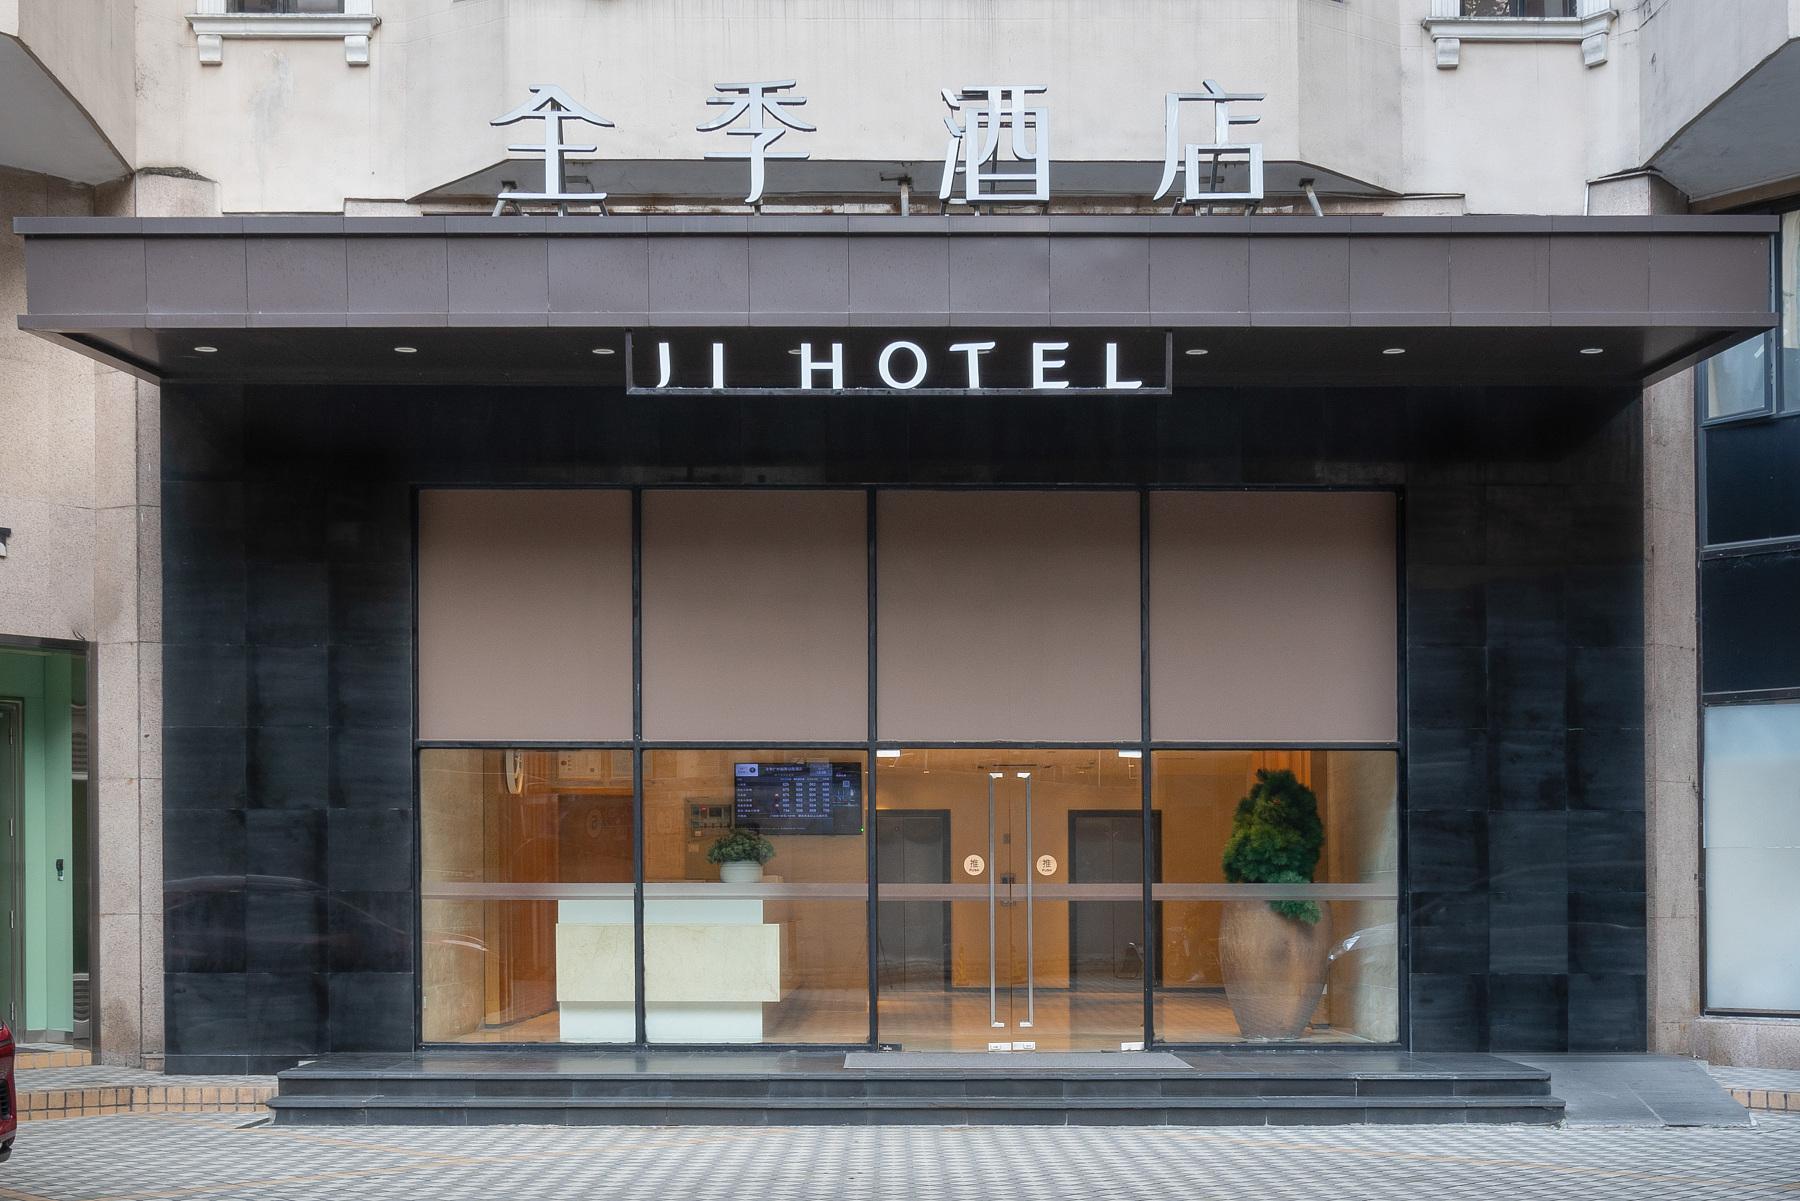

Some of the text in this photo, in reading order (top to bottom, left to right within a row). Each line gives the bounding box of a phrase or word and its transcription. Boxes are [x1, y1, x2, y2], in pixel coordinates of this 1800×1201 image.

[490, 79, 1266, 204] 全季酒店
[656, 341, 1143, 390] JI HOTEL
[970, 859, 980, 868] 推
[1042, 859, 1052, 868] 推
